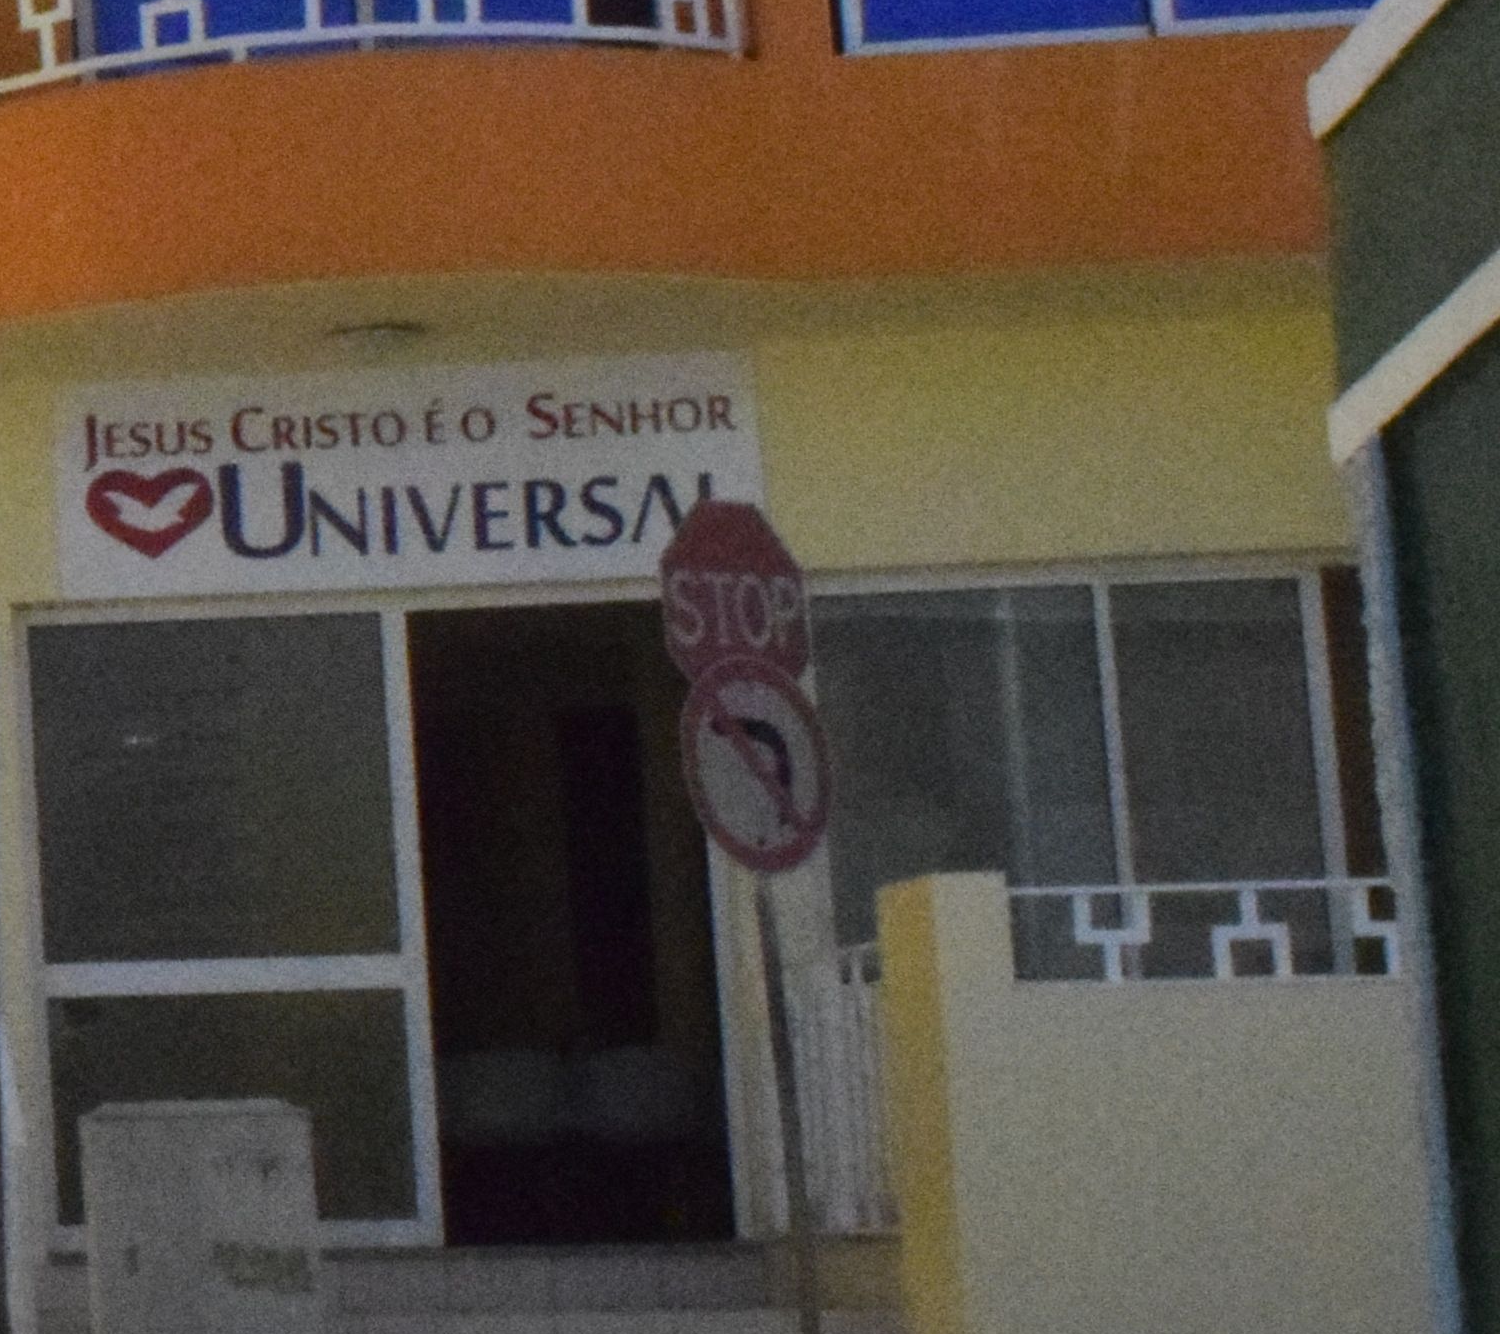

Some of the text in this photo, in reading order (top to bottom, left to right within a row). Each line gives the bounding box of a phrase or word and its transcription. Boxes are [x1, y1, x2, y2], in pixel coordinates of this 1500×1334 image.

[425, 399, 446, 444] É
[460, 407, 497, 442] O
[670, 569, 801, 650] STOP
